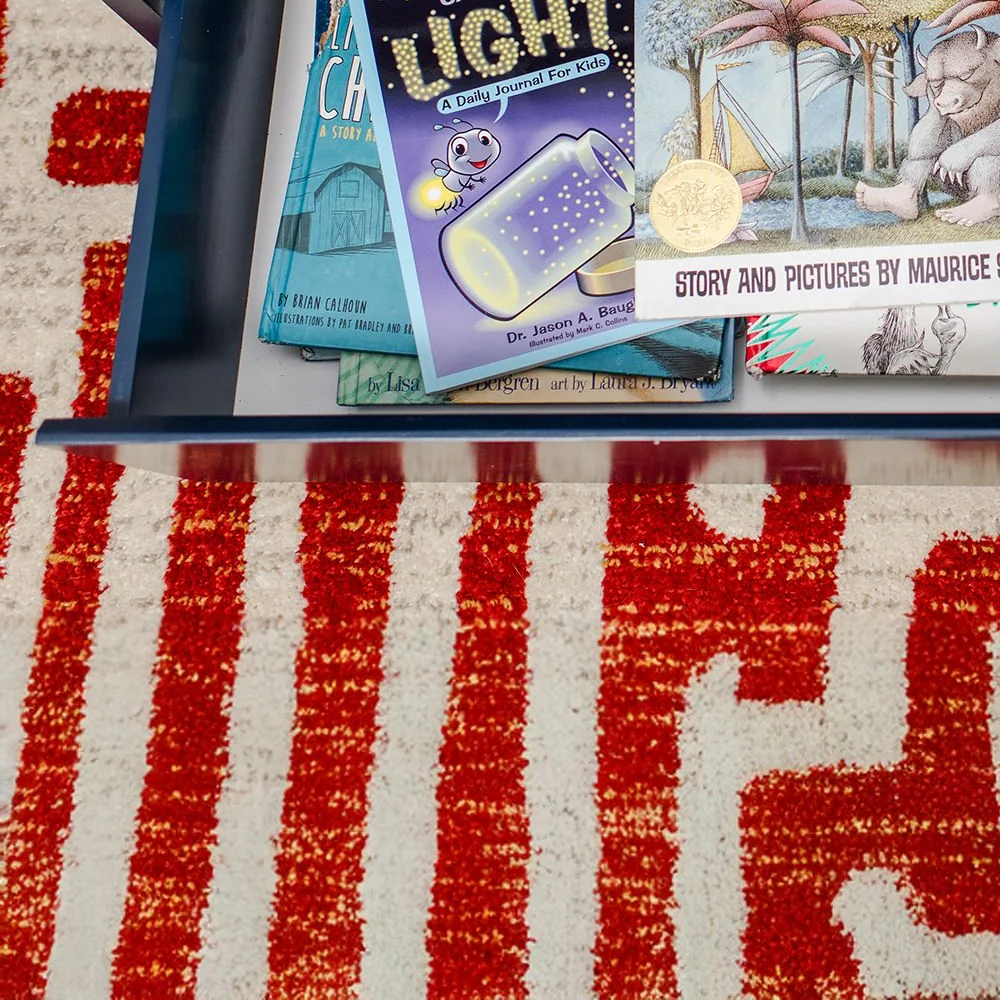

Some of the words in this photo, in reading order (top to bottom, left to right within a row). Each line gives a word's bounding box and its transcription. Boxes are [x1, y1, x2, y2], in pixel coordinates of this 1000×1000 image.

[441, 100, 452, 111] A
[457, 89, 490, 106] Daily
[495, 72, 543, 96] Journal
[548, 67, 571, 81] For
[575, 57, 607, 73] Kids
[320, 125, 327, 138] A
[332, 125, 362, 140] STORY
[675, 268, 732, 298] STORY
[738, 266, 776, 294] AND
[784, 260, 871, 292] PICTURES
[876, 258, 900, 286] BY
[908, 253, 991, 285] MAURICE
[278, 292, 289, 308] BY
[292, 293, 321, 310] BRIAN
[325, 297, 368, 314] CALHOUN
[273, 312, 325, 328] ILLUSTRATIONS
[326, 316, 337, 328] BY
[338, 317, 351, 329] PAT
[355, 319, 385, 333] BRADLEY
[386, 322, 401, 334] AND
[506, 331, 527, 344] Dr.
[532, 319, 573, 337] Jason
[578, 312, 593, 324] A.
[598, 297, 635, 318] Baug
[529, 334, 564, 348] Illustrated
[566, 331, 575, 340] by
[576, 325, 593, 335] Mark
[605, 316, 628, 327] Collins
[368, 376, 382, 395] by
[386, 372, 421, 392] Lisa
[550, 376, 568, 391] art
[572, 375, 587, 394] by
[590, 372, 638, 391] Laura
